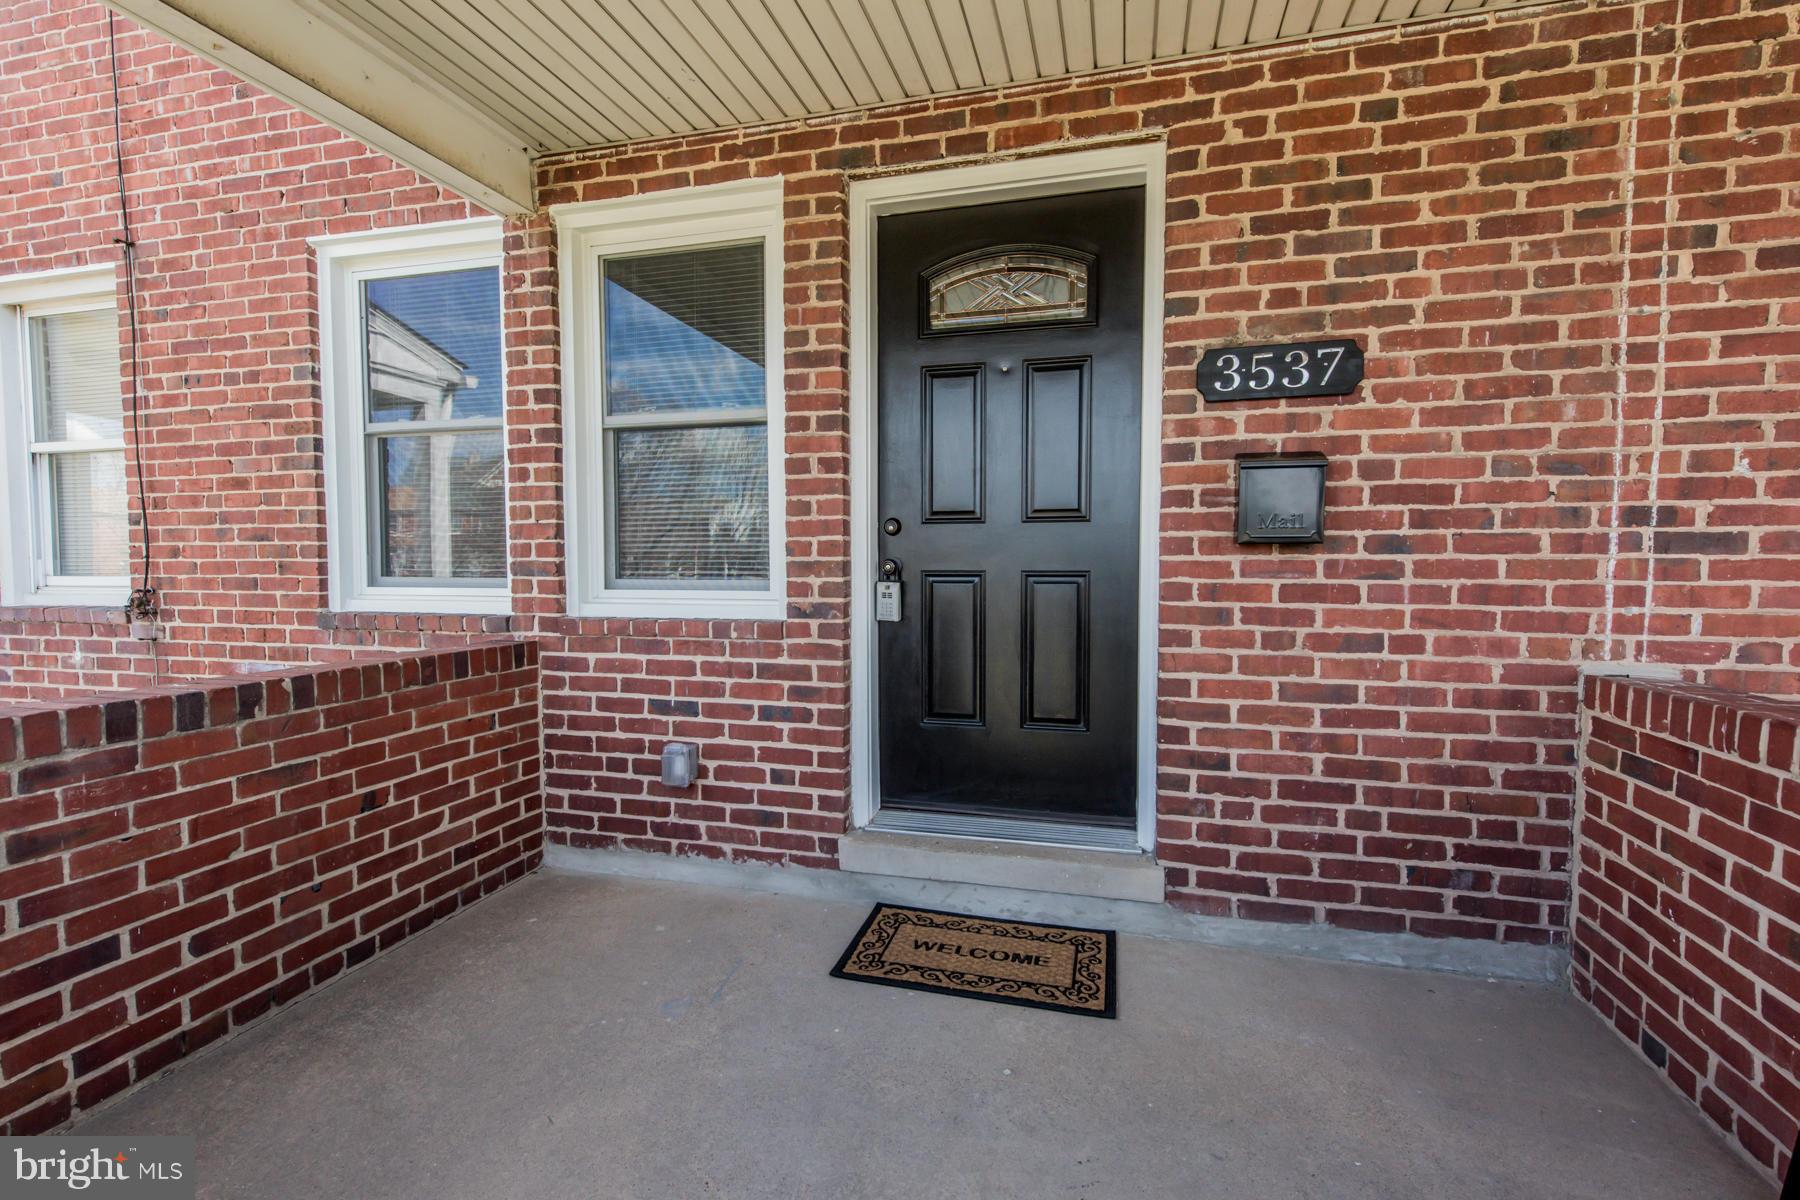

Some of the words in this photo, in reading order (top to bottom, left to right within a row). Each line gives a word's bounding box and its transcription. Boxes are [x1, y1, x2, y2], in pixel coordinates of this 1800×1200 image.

[1214, 347, 1345, 392] 3537
[1257, 513, 1304, 529] Mail
[913, 938, 1053, 967] WELCOME
